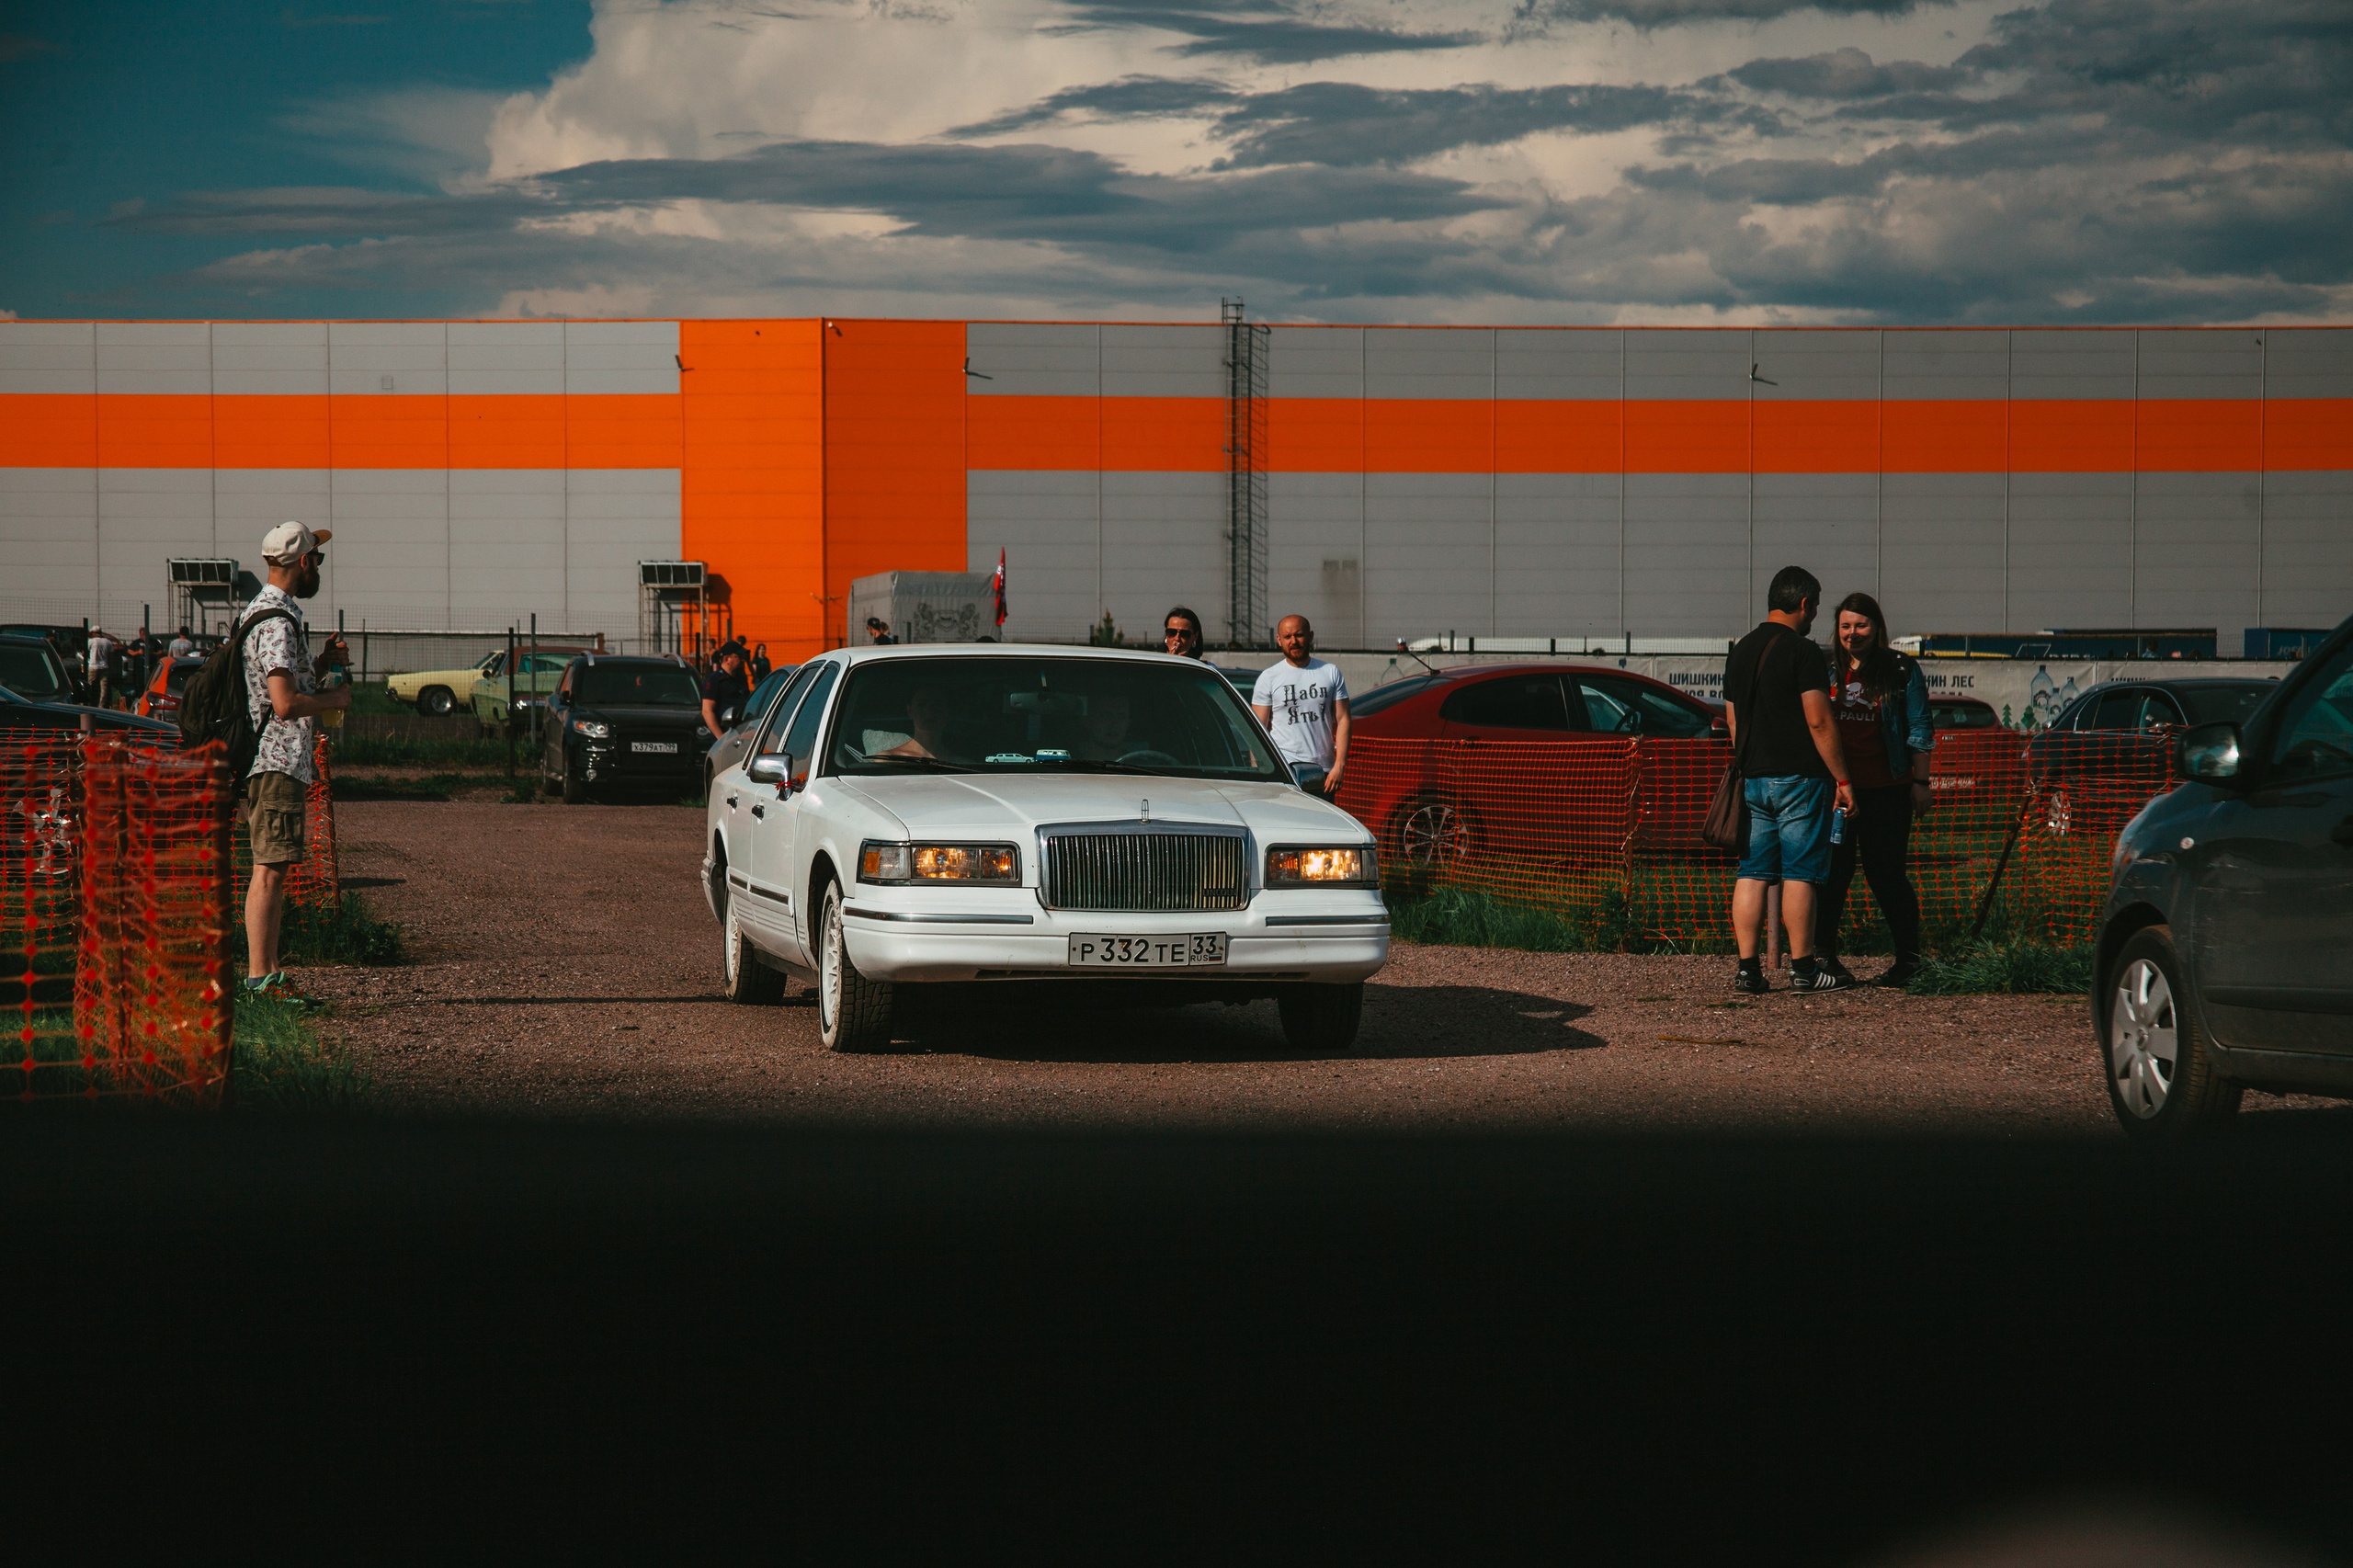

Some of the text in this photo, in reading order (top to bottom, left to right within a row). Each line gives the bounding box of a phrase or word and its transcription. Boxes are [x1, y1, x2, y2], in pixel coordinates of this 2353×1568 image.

[1669, 673, 1725, 686] ШИШКИН
[1951, 676, 1974, 687] ЛЕС
[1282, 683, 1328, 707] Дабл
[1840, 710, 1875, 722] PAULI
[1202, 888, 1237, 897] LINCOLN
[1192, 936, 1217, 955] 33
[1190, 954, 1209, 962] RUS
